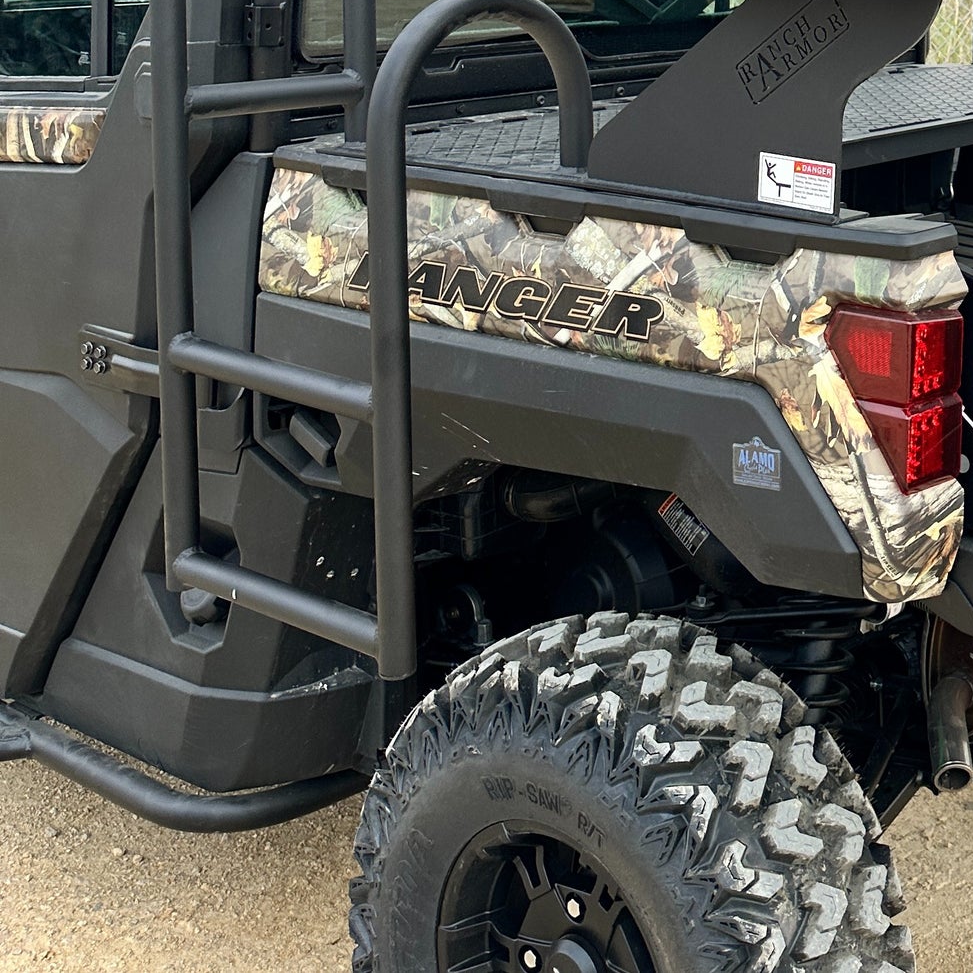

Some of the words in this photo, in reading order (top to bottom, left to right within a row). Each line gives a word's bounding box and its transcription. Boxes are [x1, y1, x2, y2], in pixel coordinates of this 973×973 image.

[740, 15, 811, 92] RANCH
[757, 13, 844, 92] ARMOR
[801, 164, 832, 176] DANGER
[347, 252, 665, 341] ANGER
[738, 449, 775, 473] ALAMO
[577, 811, 607, 847] R/T
